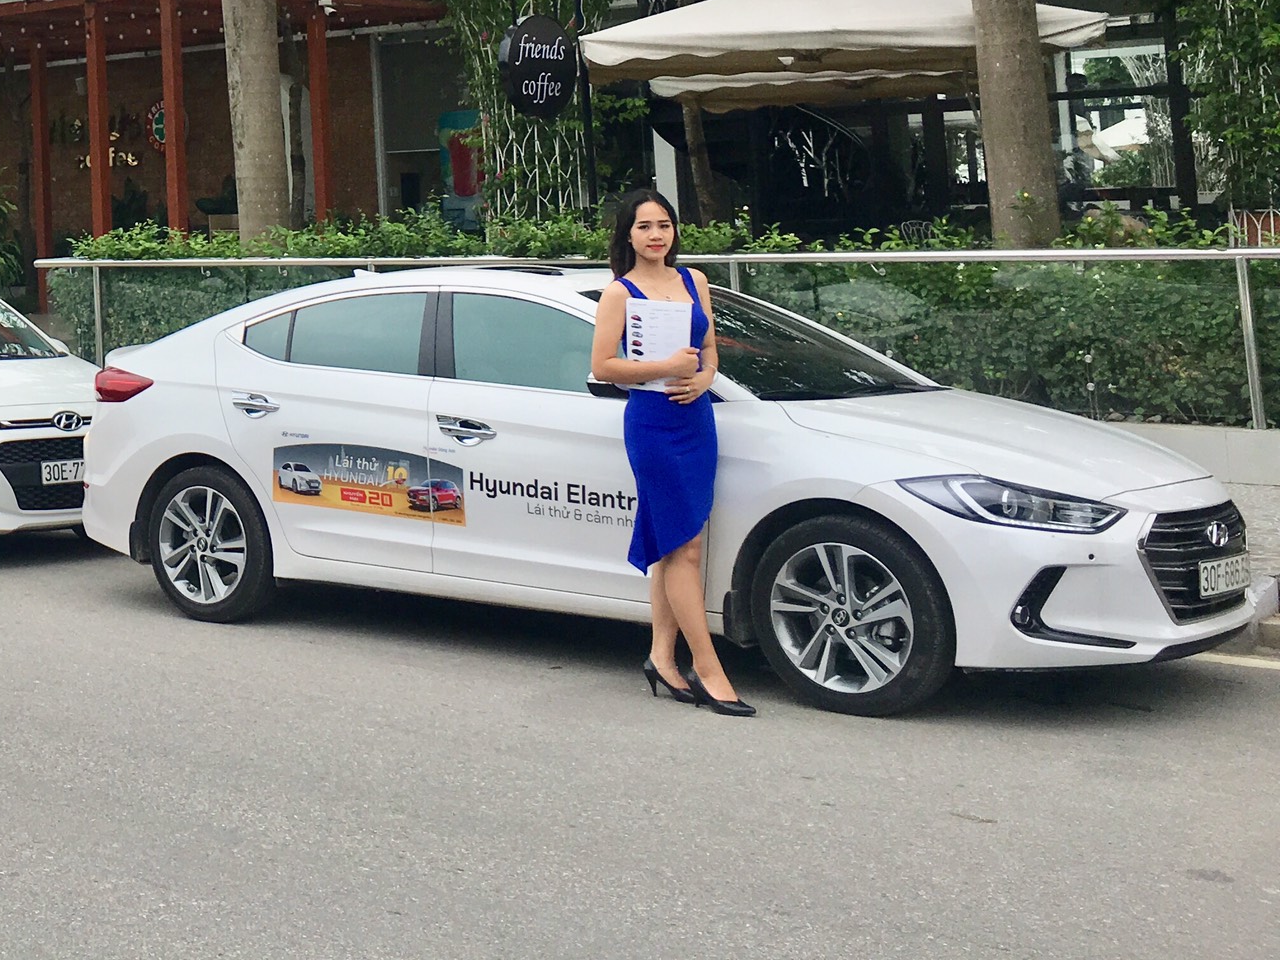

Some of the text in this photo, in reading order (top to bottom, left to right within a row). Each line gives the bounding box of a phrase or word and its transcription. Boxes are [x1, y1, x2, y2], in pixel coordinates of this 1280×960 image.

[515, 34, 566, 65] friends
[522, 72, 562, 103] coffee
[335, 455, 354, 469] Lái
[356, 456, 380, 471] thử
[323, 468, 379, 487] HYUNDAI
[368, 491, 393, 508] 20
[470, 471, 637, 511] Hyundai Elantr
[527, 502, 635, 528] Lái thử & cảm nh
